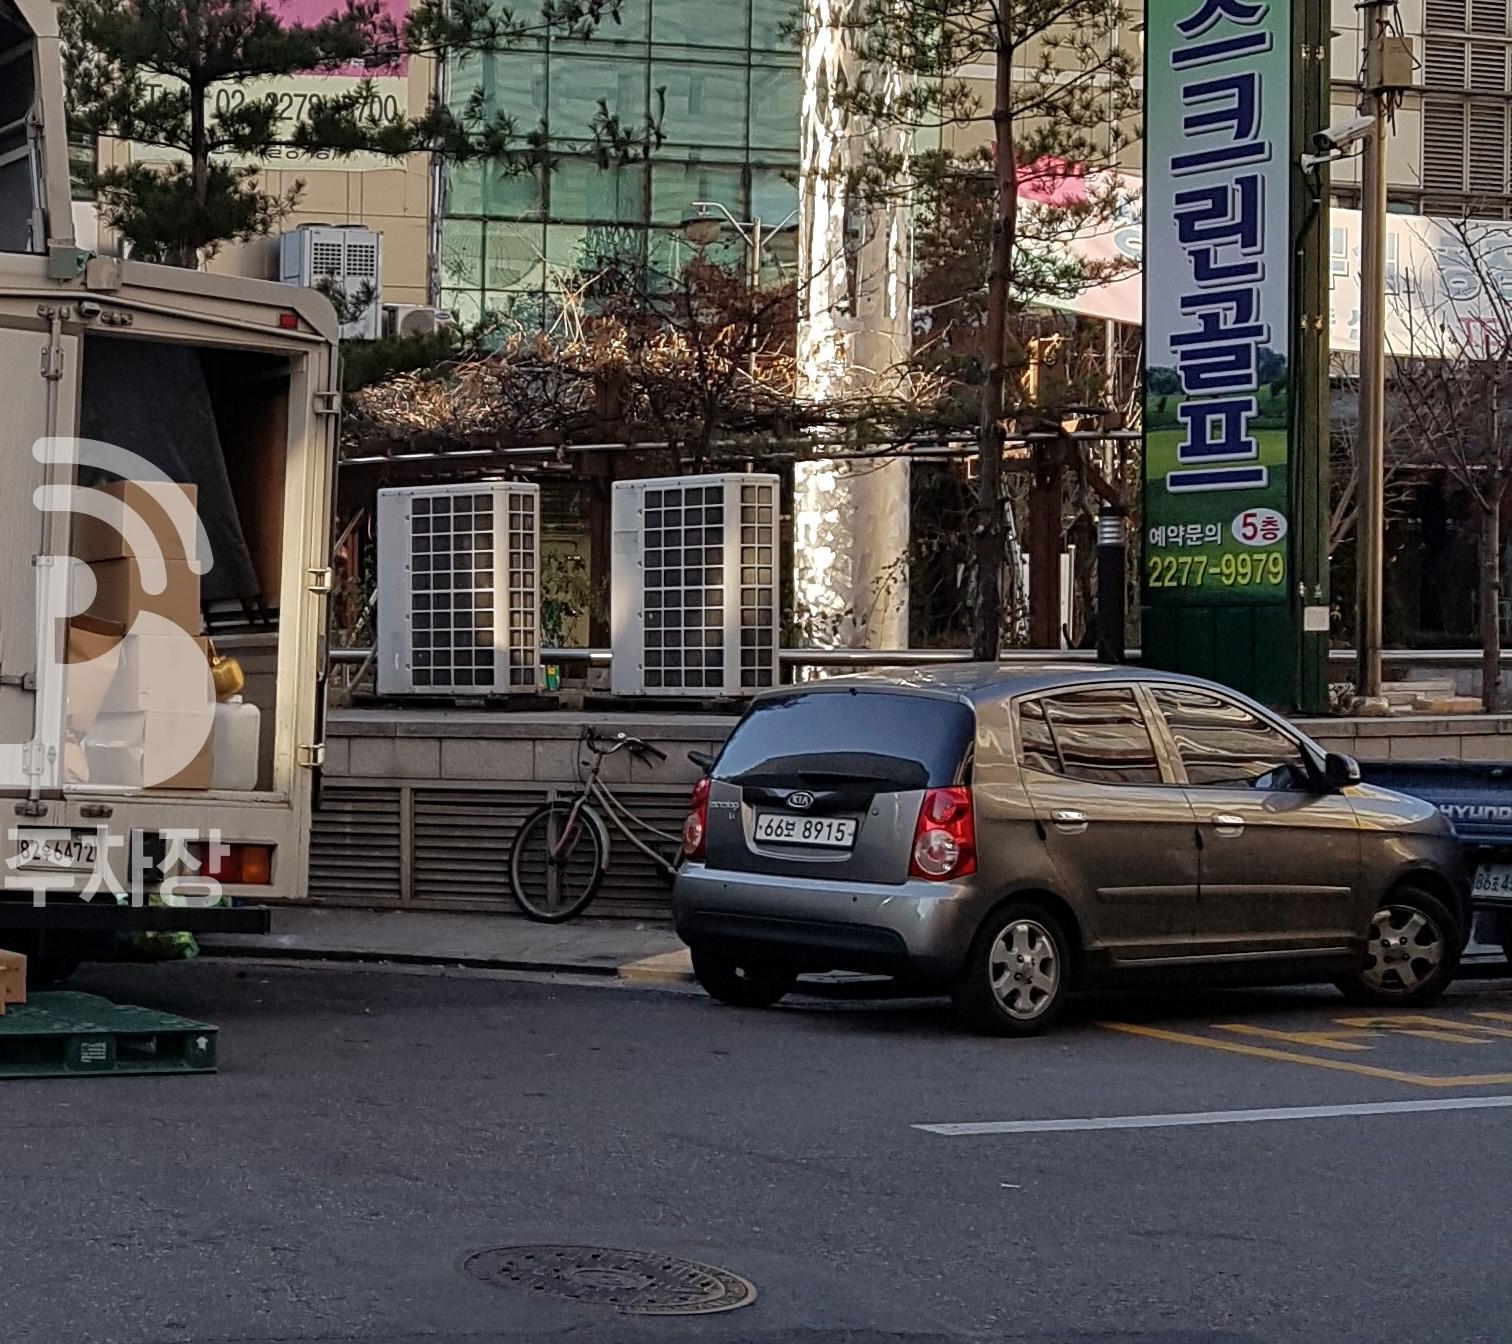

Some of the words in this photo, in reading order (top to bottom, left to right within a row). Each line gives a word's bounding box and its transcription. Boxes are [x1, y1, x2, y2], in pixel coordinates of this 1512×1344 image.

[1149, 522, 1223, 547] 예약문의
[1241, 512, 1281, 542] 5층
[1148, 552, 1285, 588] 2277-9979
[802, 820, 846, 842] 8915
